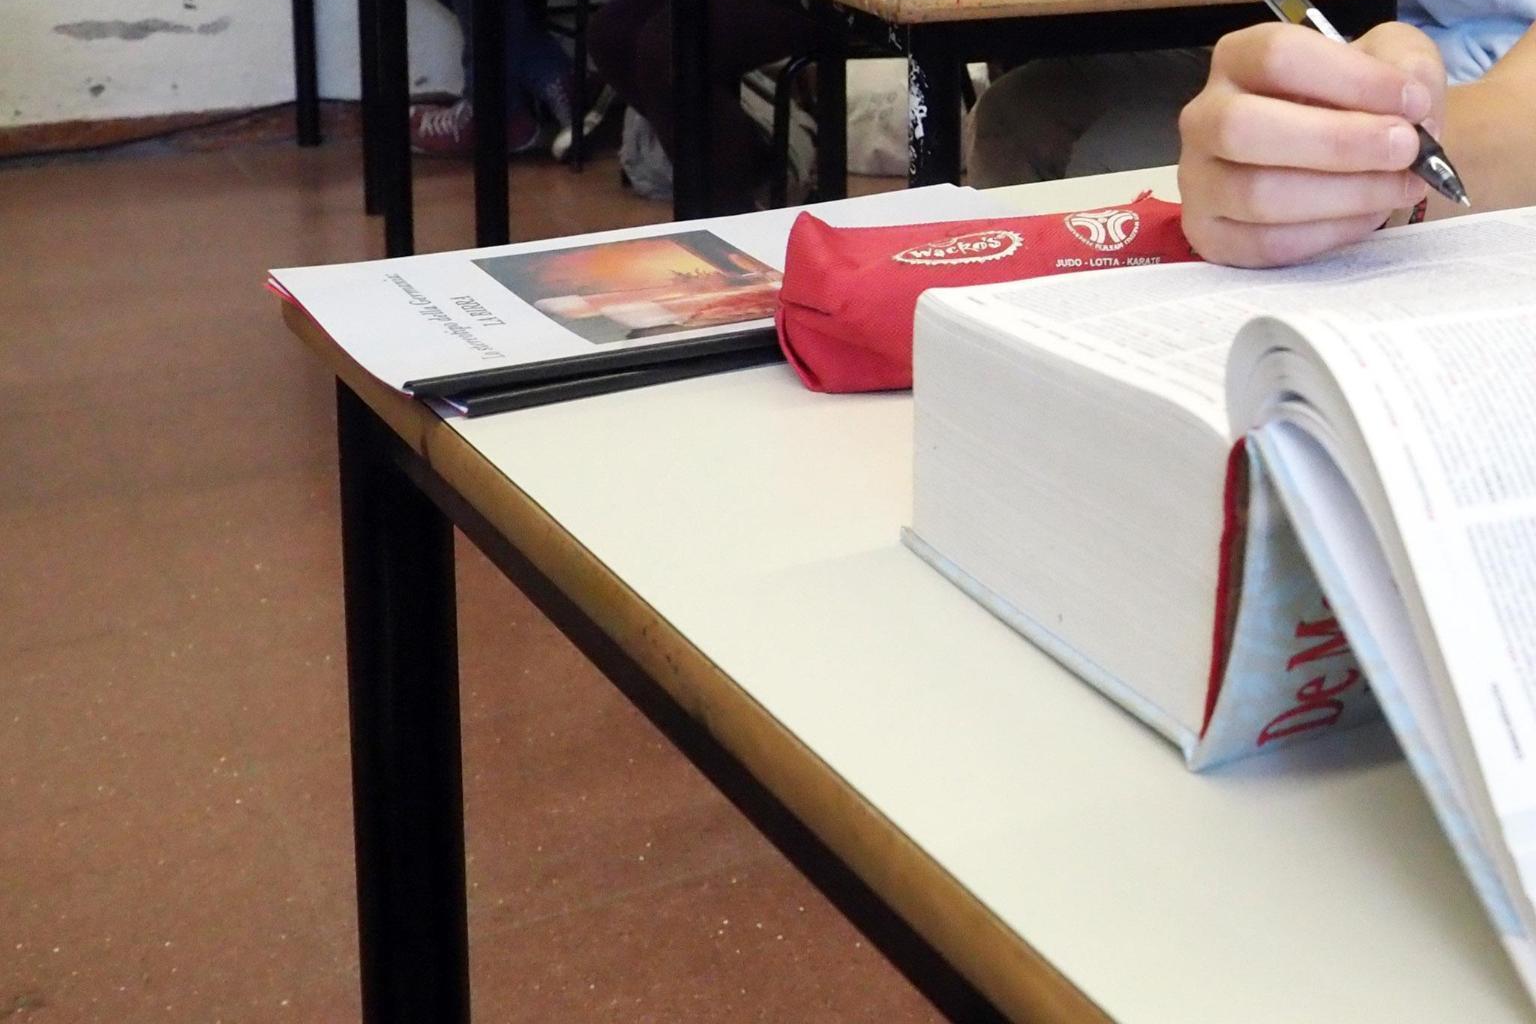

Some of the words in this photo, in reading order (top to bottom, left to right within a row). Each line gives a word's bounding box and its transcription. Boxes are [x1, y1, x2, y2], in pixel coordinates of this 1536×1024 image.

[1056, 258, 1082, 267] JUDO
[1090, 257, 1120, 267] LOTTA
[1127, 256, 1161, 266] KARATE
